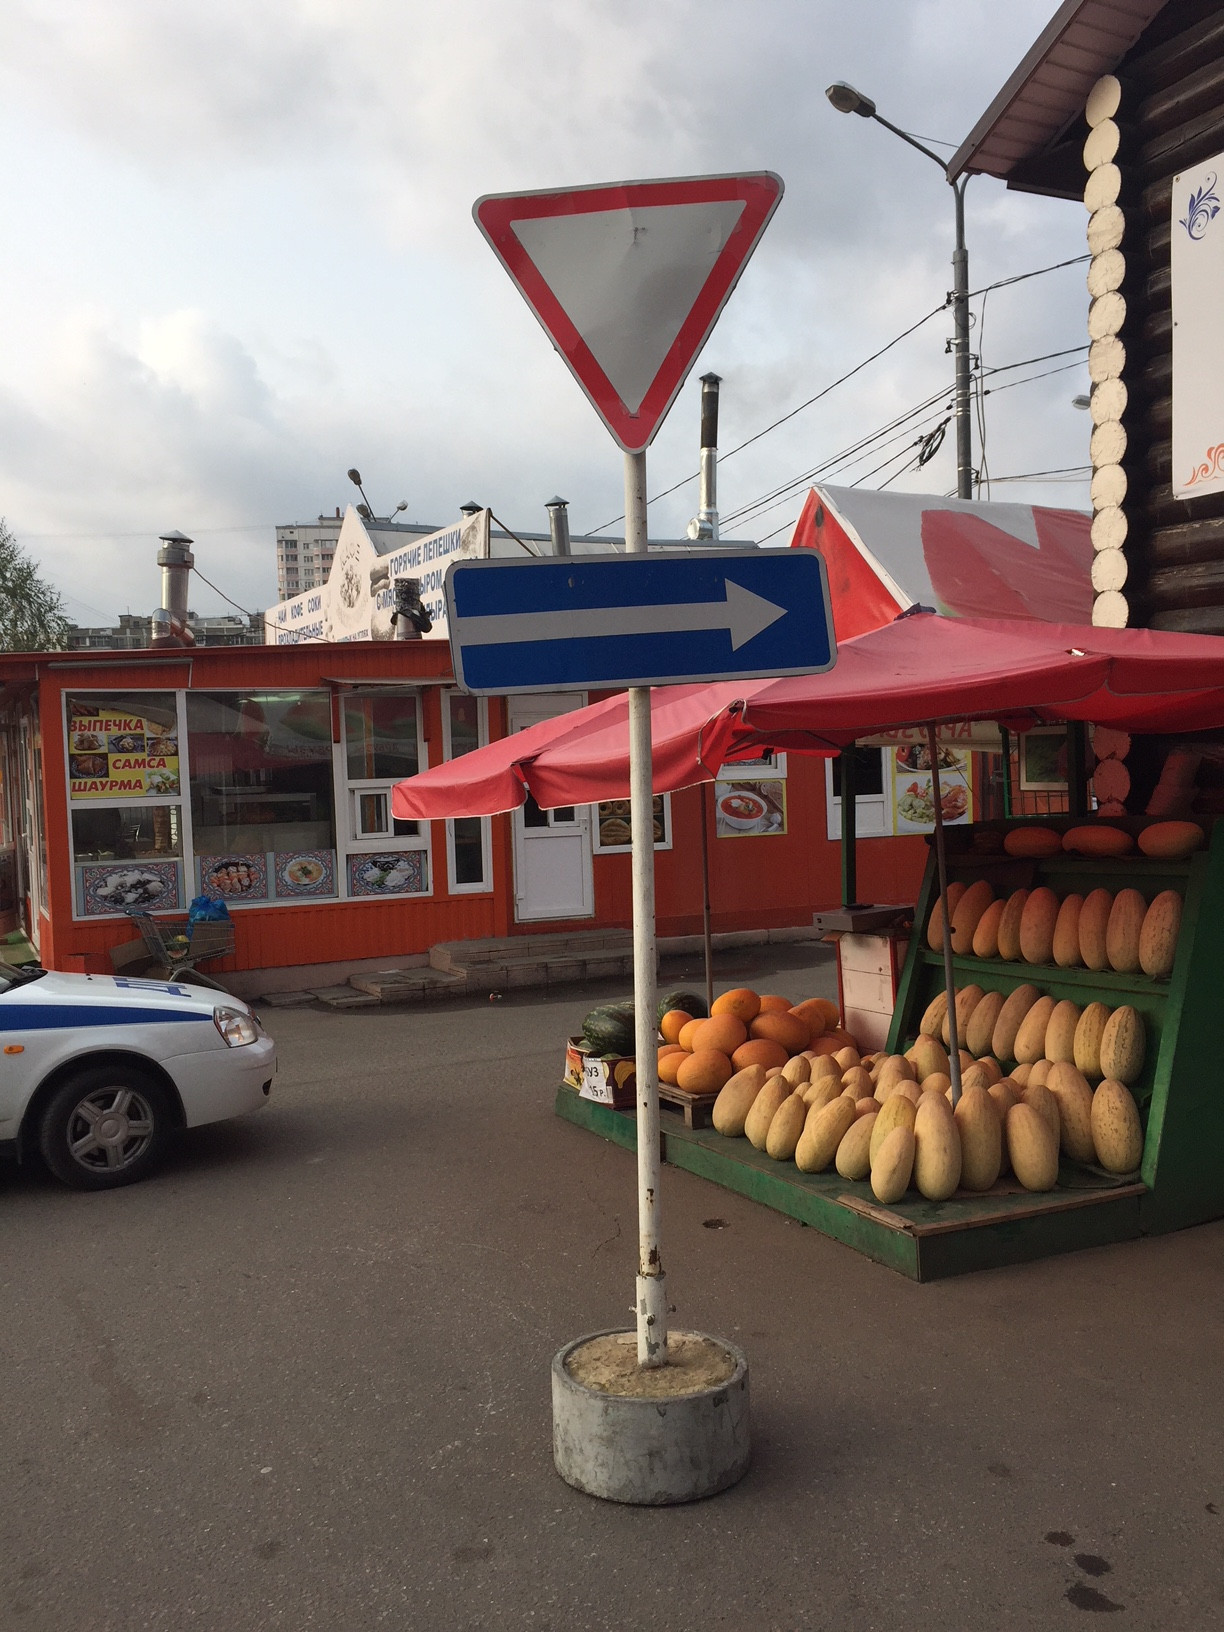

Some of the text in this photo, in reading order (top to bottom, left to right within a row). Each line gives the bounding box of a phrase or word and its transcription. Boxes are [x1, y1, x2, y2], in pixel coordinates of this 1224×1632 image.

[390, 528, 461, 577] ГОРЯЧИЕ ЛЕПЕШКИ
[419, 569, 443, 595] ЫРОМ
[307, 594, 321, 614] СОКИ
[70, 719, 145, 732] ВЫПЕЧКА
[112, 758, 167, 770] САМСА
[71, 779, 144, 793] ШАУРМА
[585, 1066, 599, 1077] УЗ
